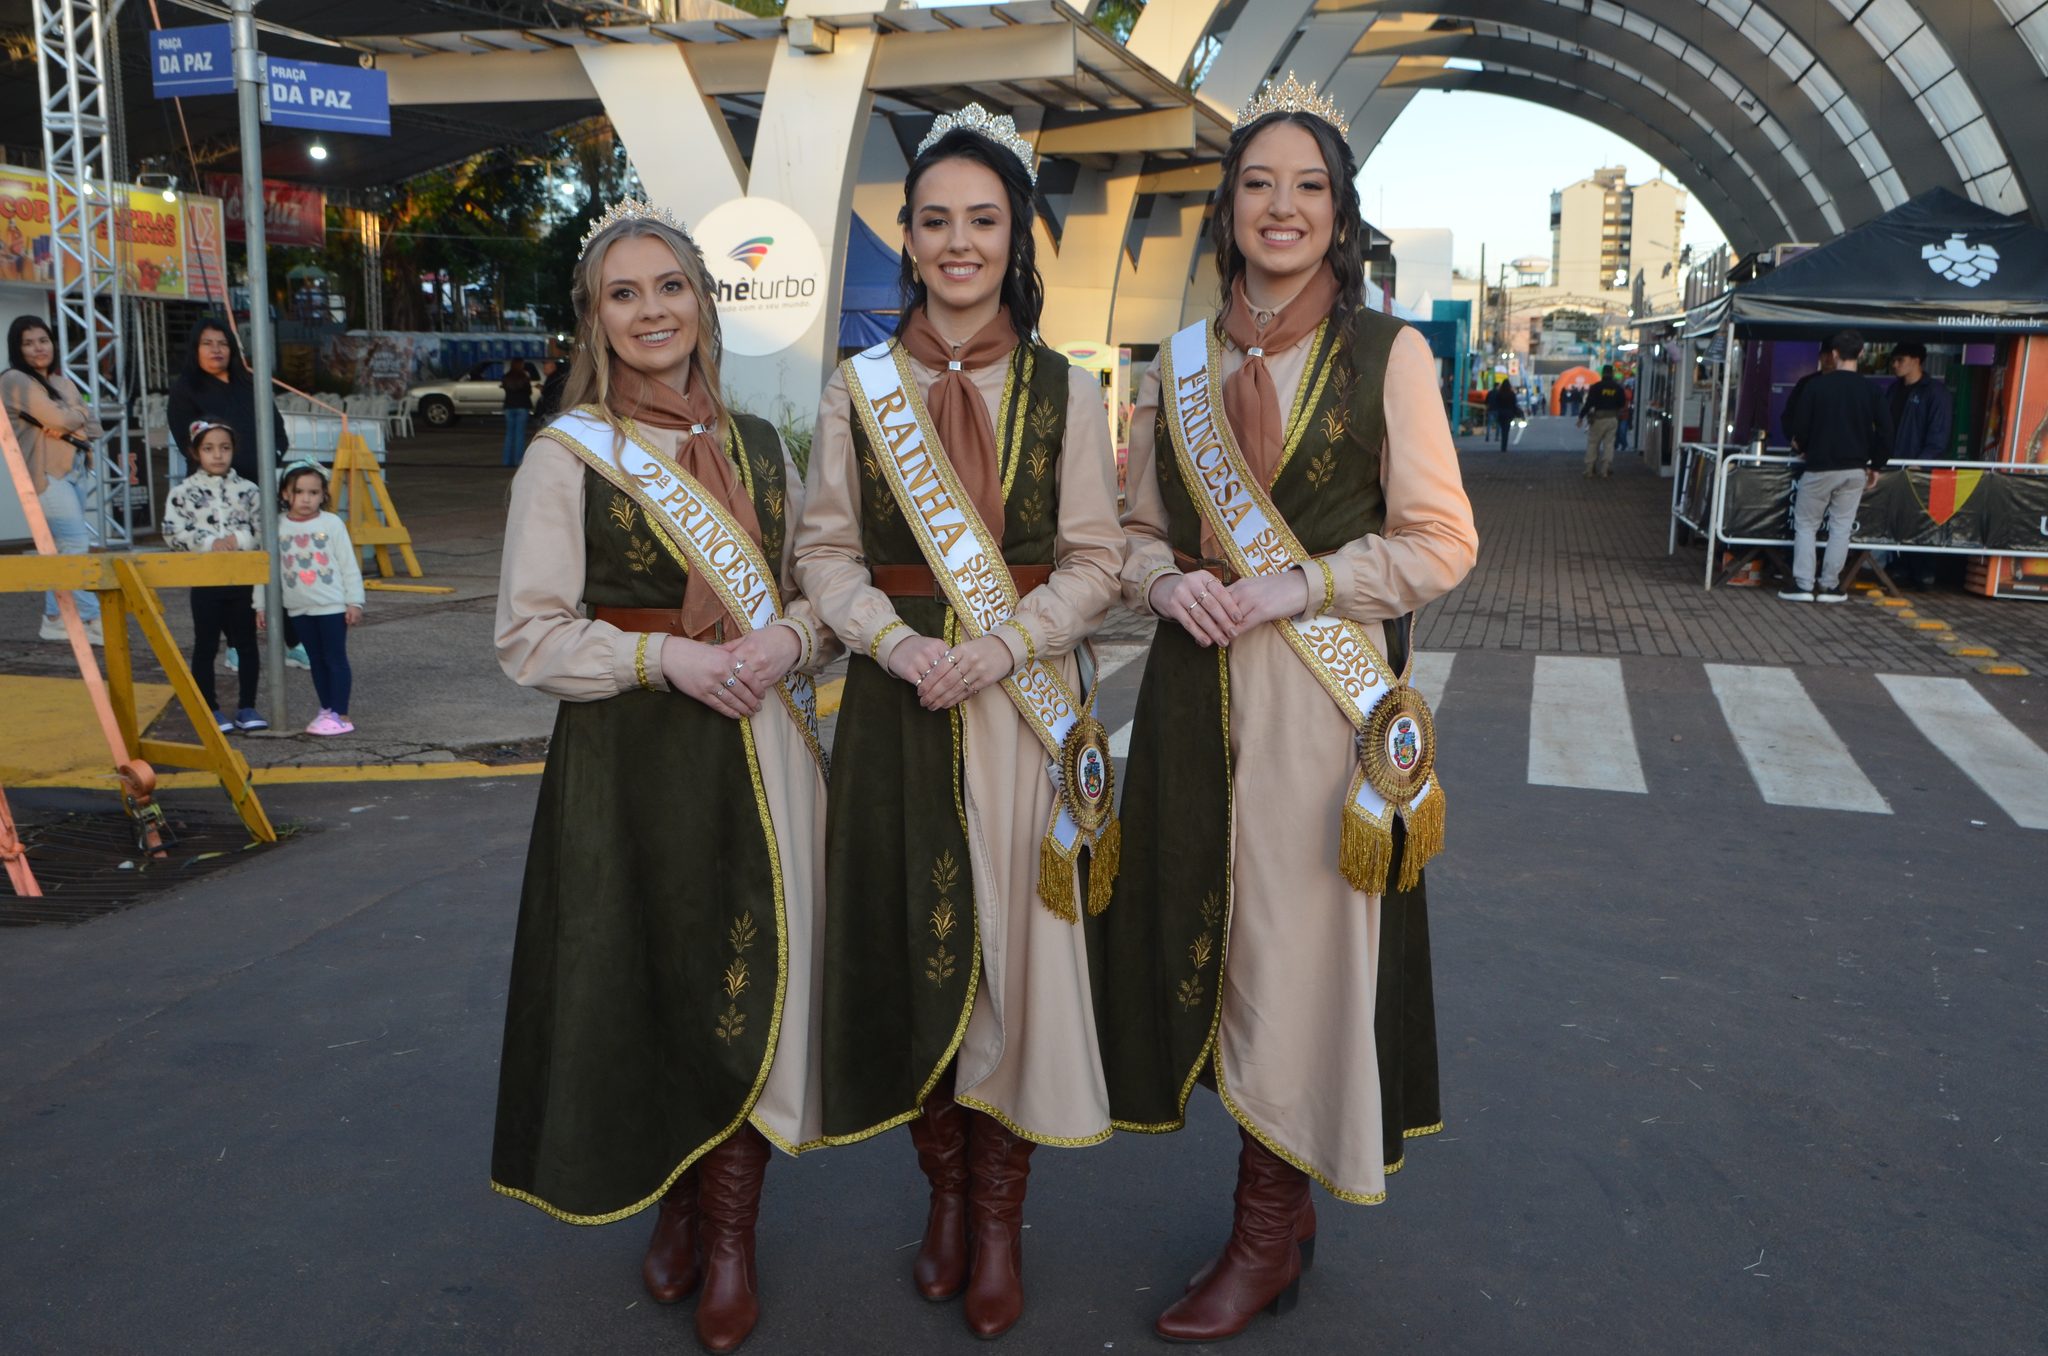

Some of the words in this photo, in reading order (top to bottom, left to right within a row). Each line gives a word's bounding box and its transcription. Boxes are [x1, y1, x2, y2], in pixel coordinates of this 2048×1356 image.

[158, 38, 182, 52] PRAÇA
[159, 55, 180, 74] DA
[184, 52, 213, 73] PAZ
[271, 65, 307, 82] PRAÇA
[272, 83, 304, 105] DA
[310, 87, 352, 110] PAZ
[717, 275, 815, 302] hêturbo
[1938, 313, 2042, 328] unsabier.com.br
[871, 385, 970, 557] RAINHA
[1179, 386, 1254, 532] PRINCESA
[659, 484, 768, 620] PRINCESA
[1303, 625, 1365, 698] 2026
[1321, 623, 1379, 688] AGRO
